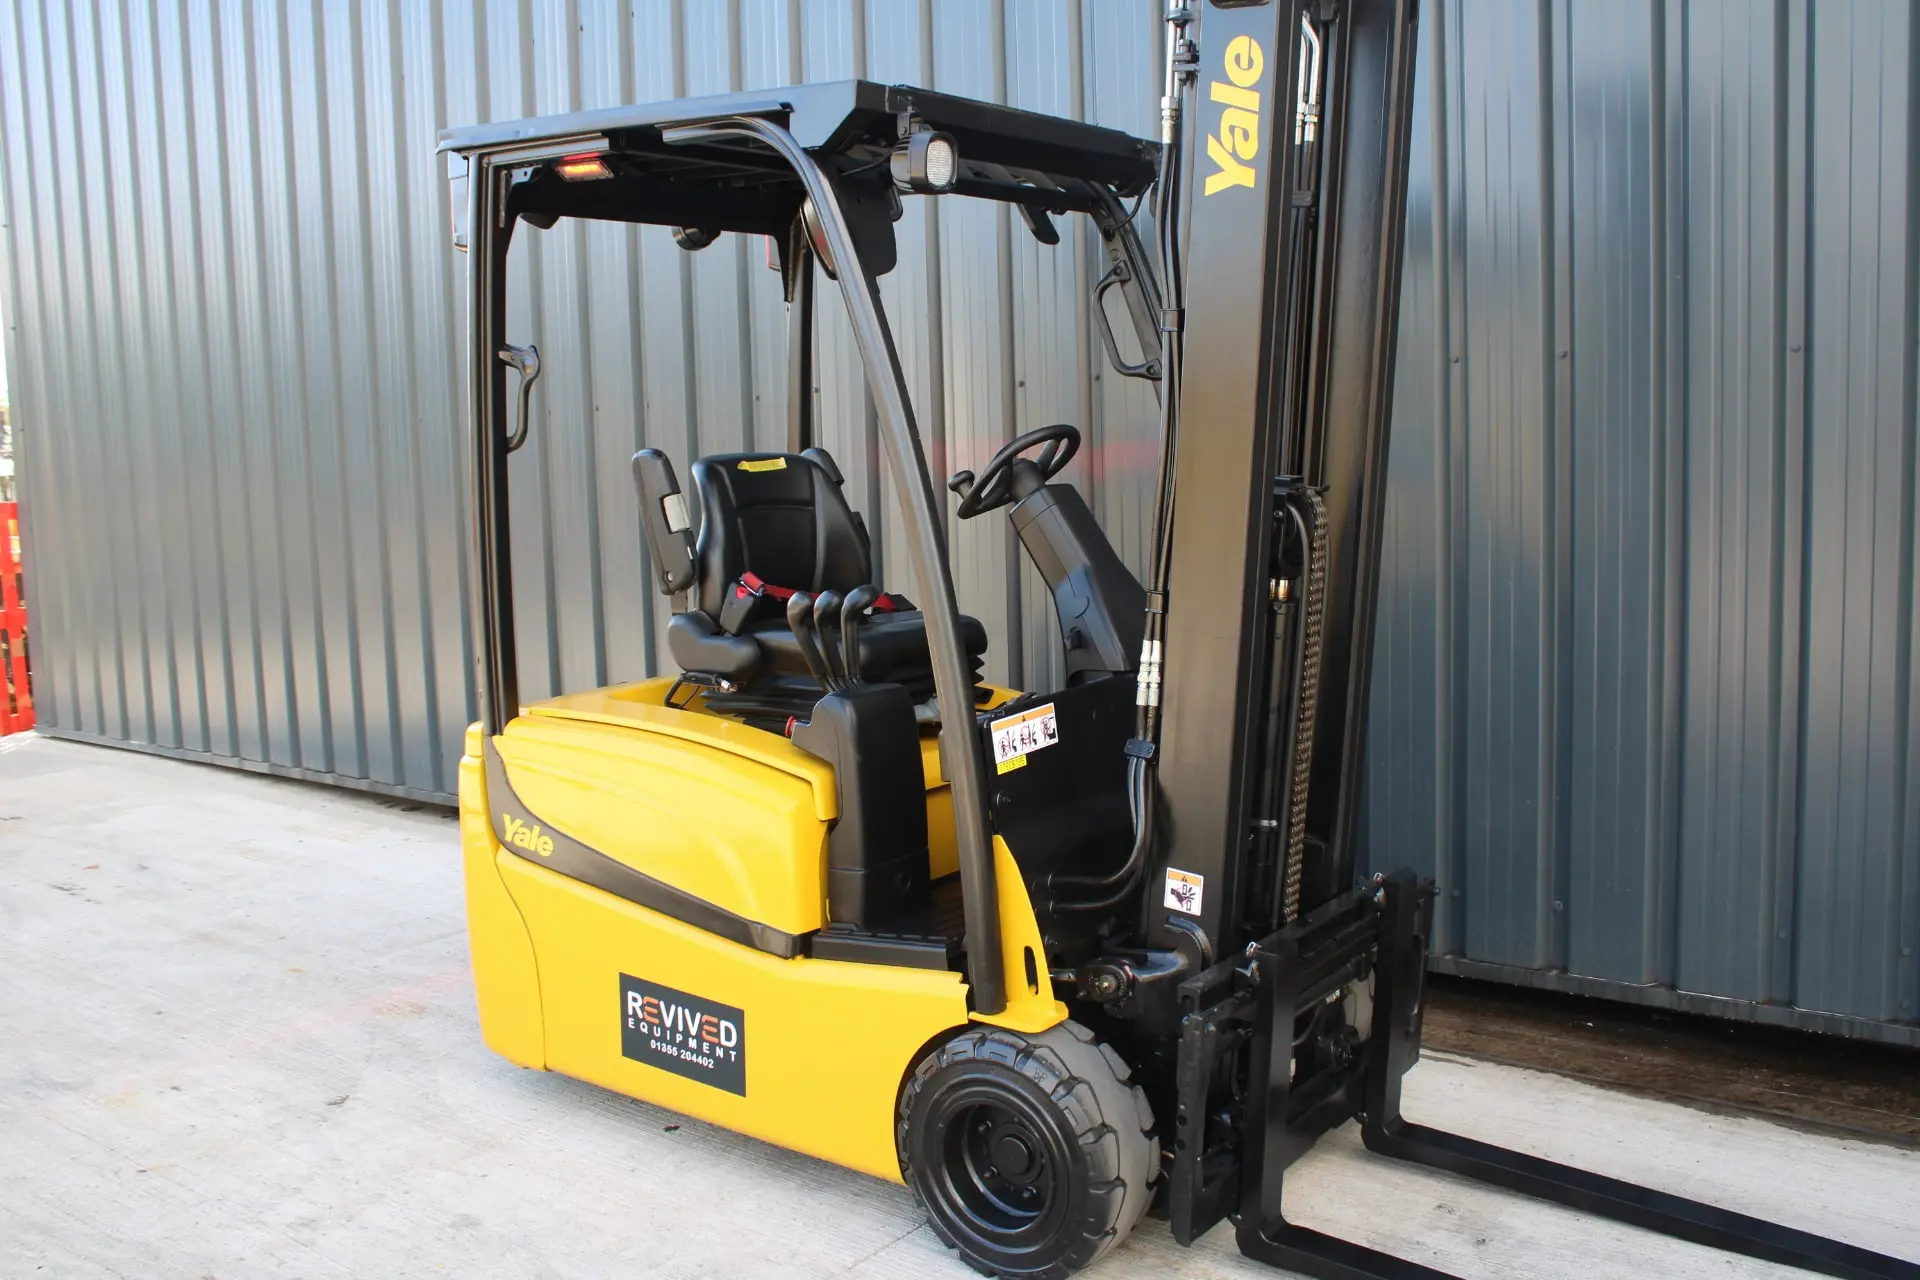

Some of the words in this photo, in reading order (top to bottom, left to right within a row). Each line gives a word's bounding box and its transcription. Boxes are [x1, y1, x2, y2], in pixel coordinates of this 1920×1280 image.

[1204, 35, 1264, 197] Yale
[502, 813, 554, 857] Yale
[627, 990, 738, 1048] REVIVED
[628, 1017, 737, 1063] EQUIPMENT
[650, 1039, 678, 1057] 01355
[680, 1049, 714, 1069] 204402
